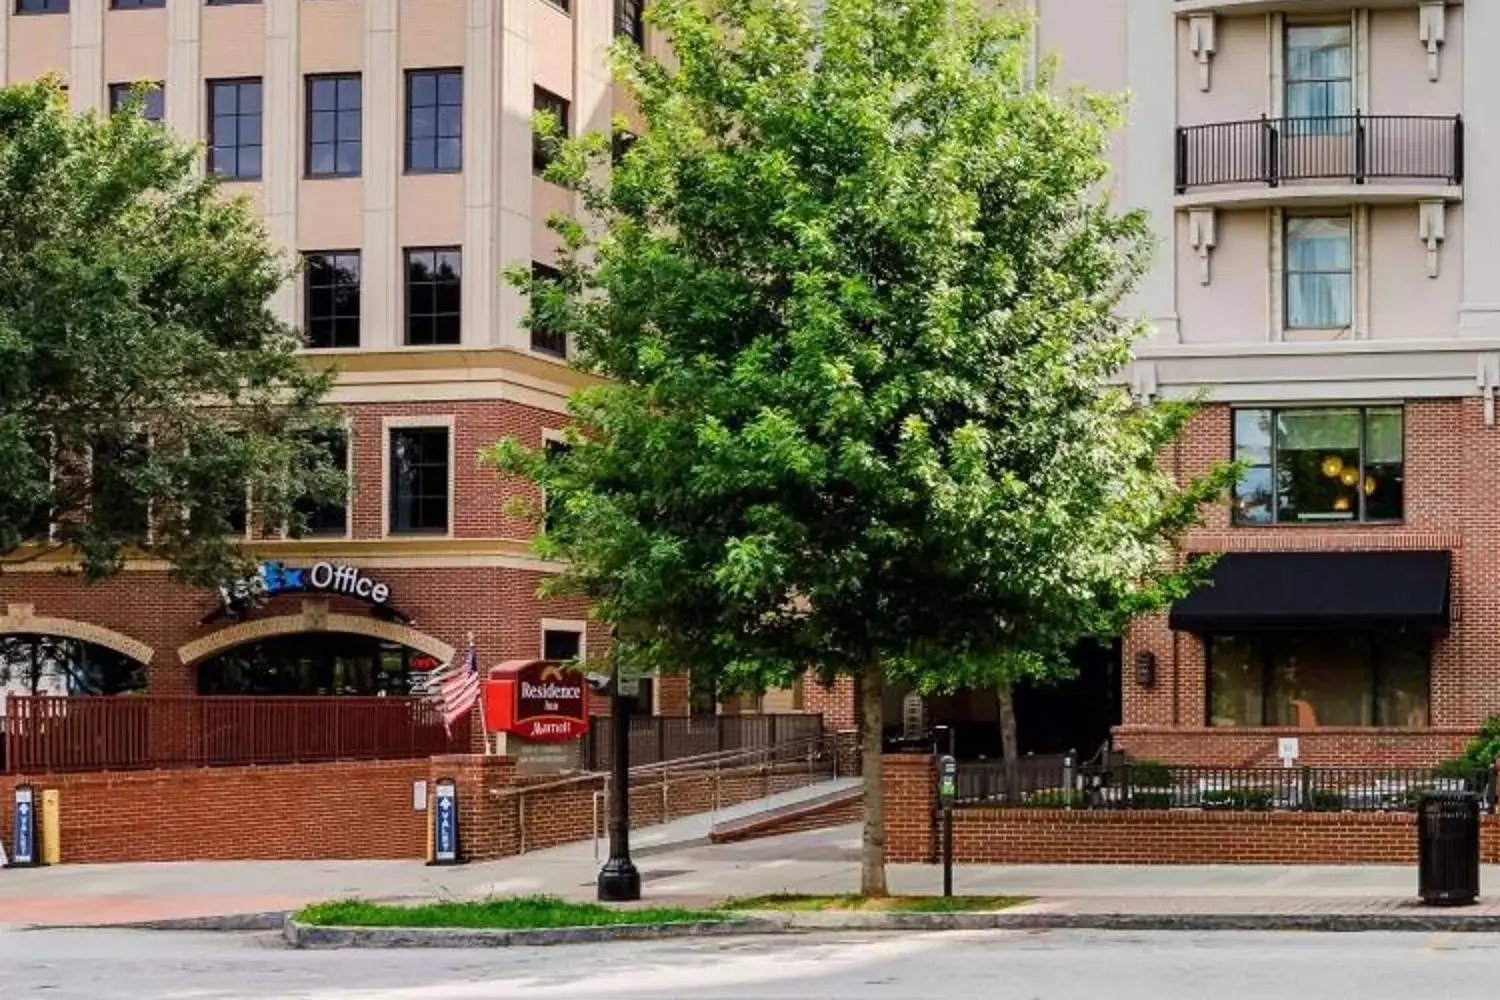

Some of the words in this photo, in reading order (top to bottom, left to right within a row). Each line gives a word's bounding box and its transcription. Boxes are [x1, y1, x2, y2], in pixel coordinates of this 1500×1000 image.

[310, 561, 389, 603] Office
[521, 681, 581, 699] Residence
[530, 721, 571, 736] Marriott
